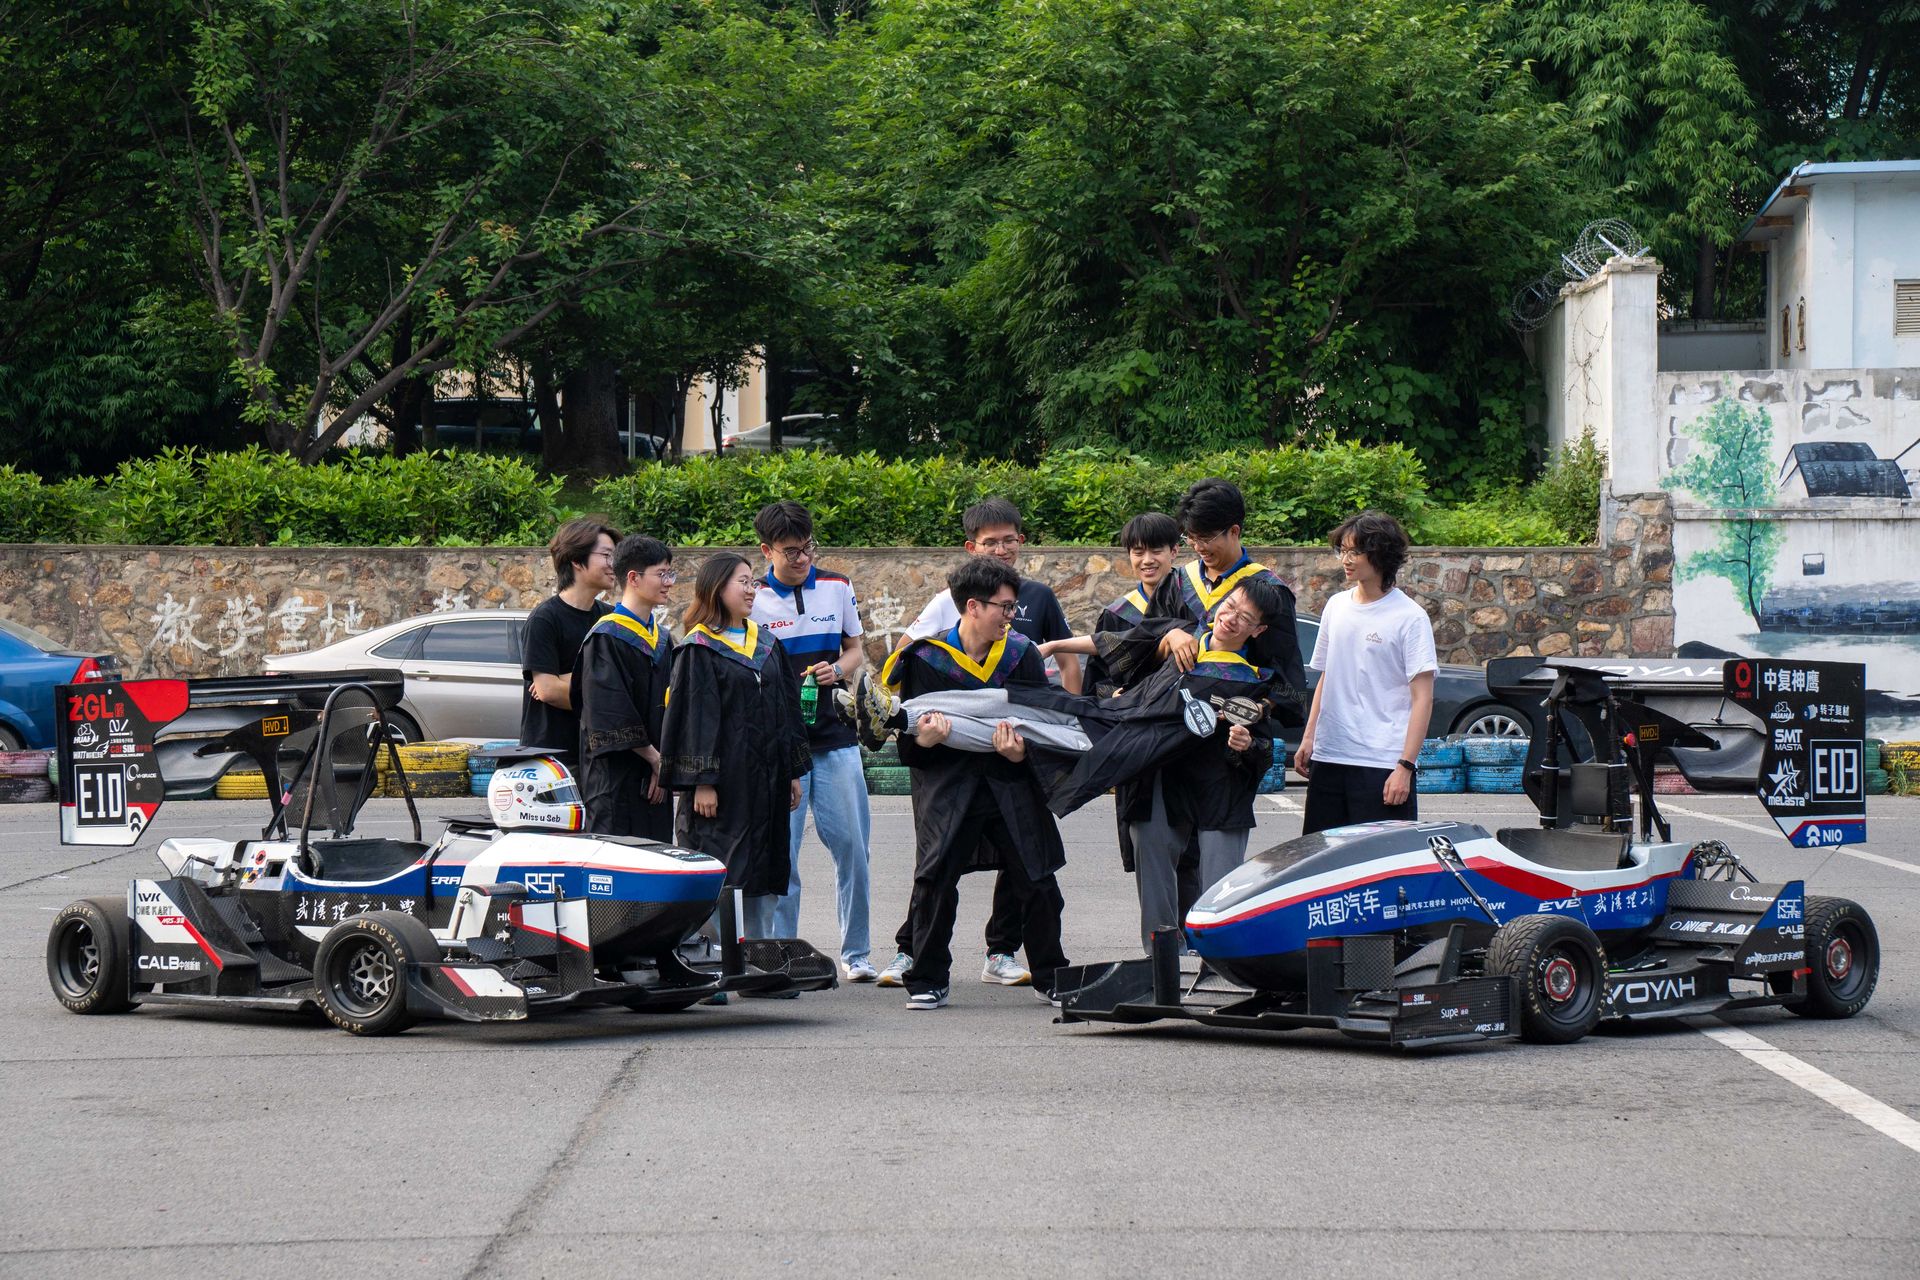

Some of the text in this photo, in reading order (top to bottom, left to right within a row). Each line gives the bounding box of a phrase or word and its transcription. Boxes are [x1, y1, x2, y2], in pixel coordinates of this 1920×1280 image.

[770, 621, 789, 629] ZGL
[1764, 668, 1820, 693] 中复神鹰
[69, 693, 114, 721] ZGL
[1770, 712, 1795, 720] HUAHAI
[264, 721, 280, 733] HVD
[1641, 727, 1655, 738] HVD
[1775, 729, 1803, 743] SMT
[1774, 743, 1803, 751] MASTA
[1815, 748, 1858, 794] E03
[79, 773, 122, 818] E10
[520, 812, 538, 821] Miss
[1823, 829, 1843, 842] NIO
[1450, 897, 1473, 906] HIOKI
[136, 905, 173, 915] ONE KART
[1308, 888, 1380, 930] 岚图汽车
[1778, 925, 1805, 935] CALB
[138, 956, 179, 970] CALB
[1609, 976, 1696, 1004] VOYAH
